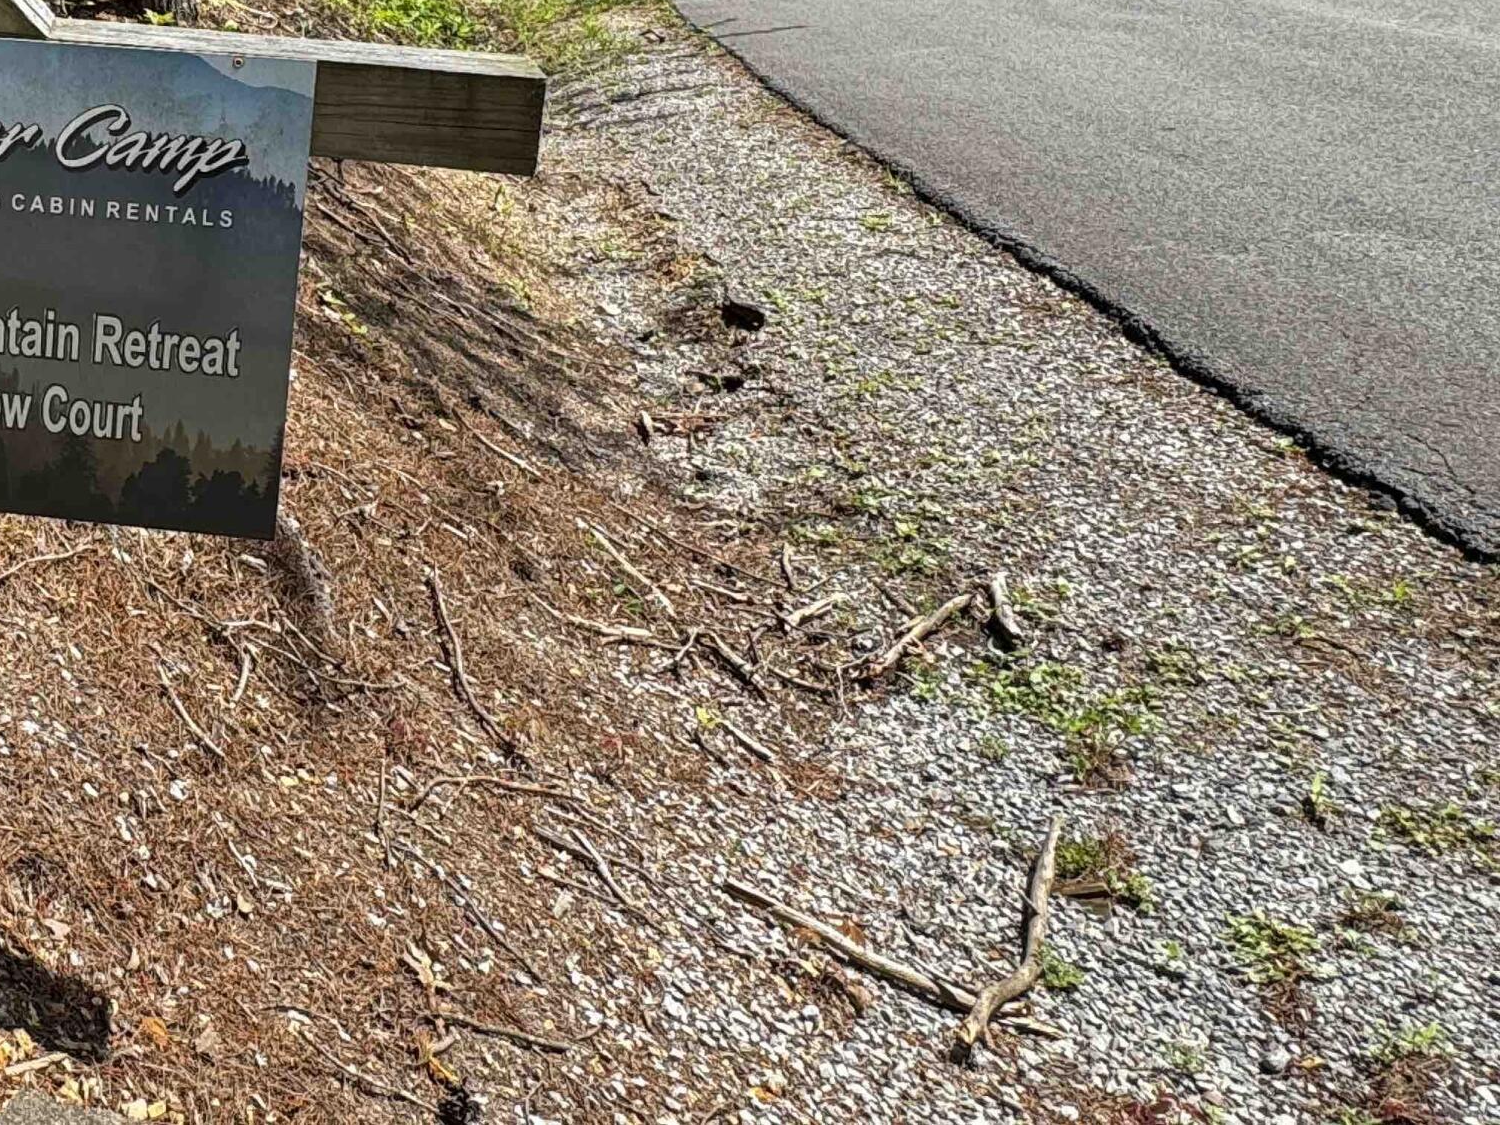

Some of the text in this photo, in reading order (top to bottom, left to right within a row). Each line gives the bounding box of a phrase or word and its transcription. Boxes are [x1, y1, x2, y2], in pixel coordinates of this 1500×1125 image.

[54, 104, 248, 192] Camp
[11, 193, 96, 217] CABIN
[106, 199, 234, 229] RENTALS
[94, 313, 241, 377] Retreat
[41, 385, 145, 443] Court
